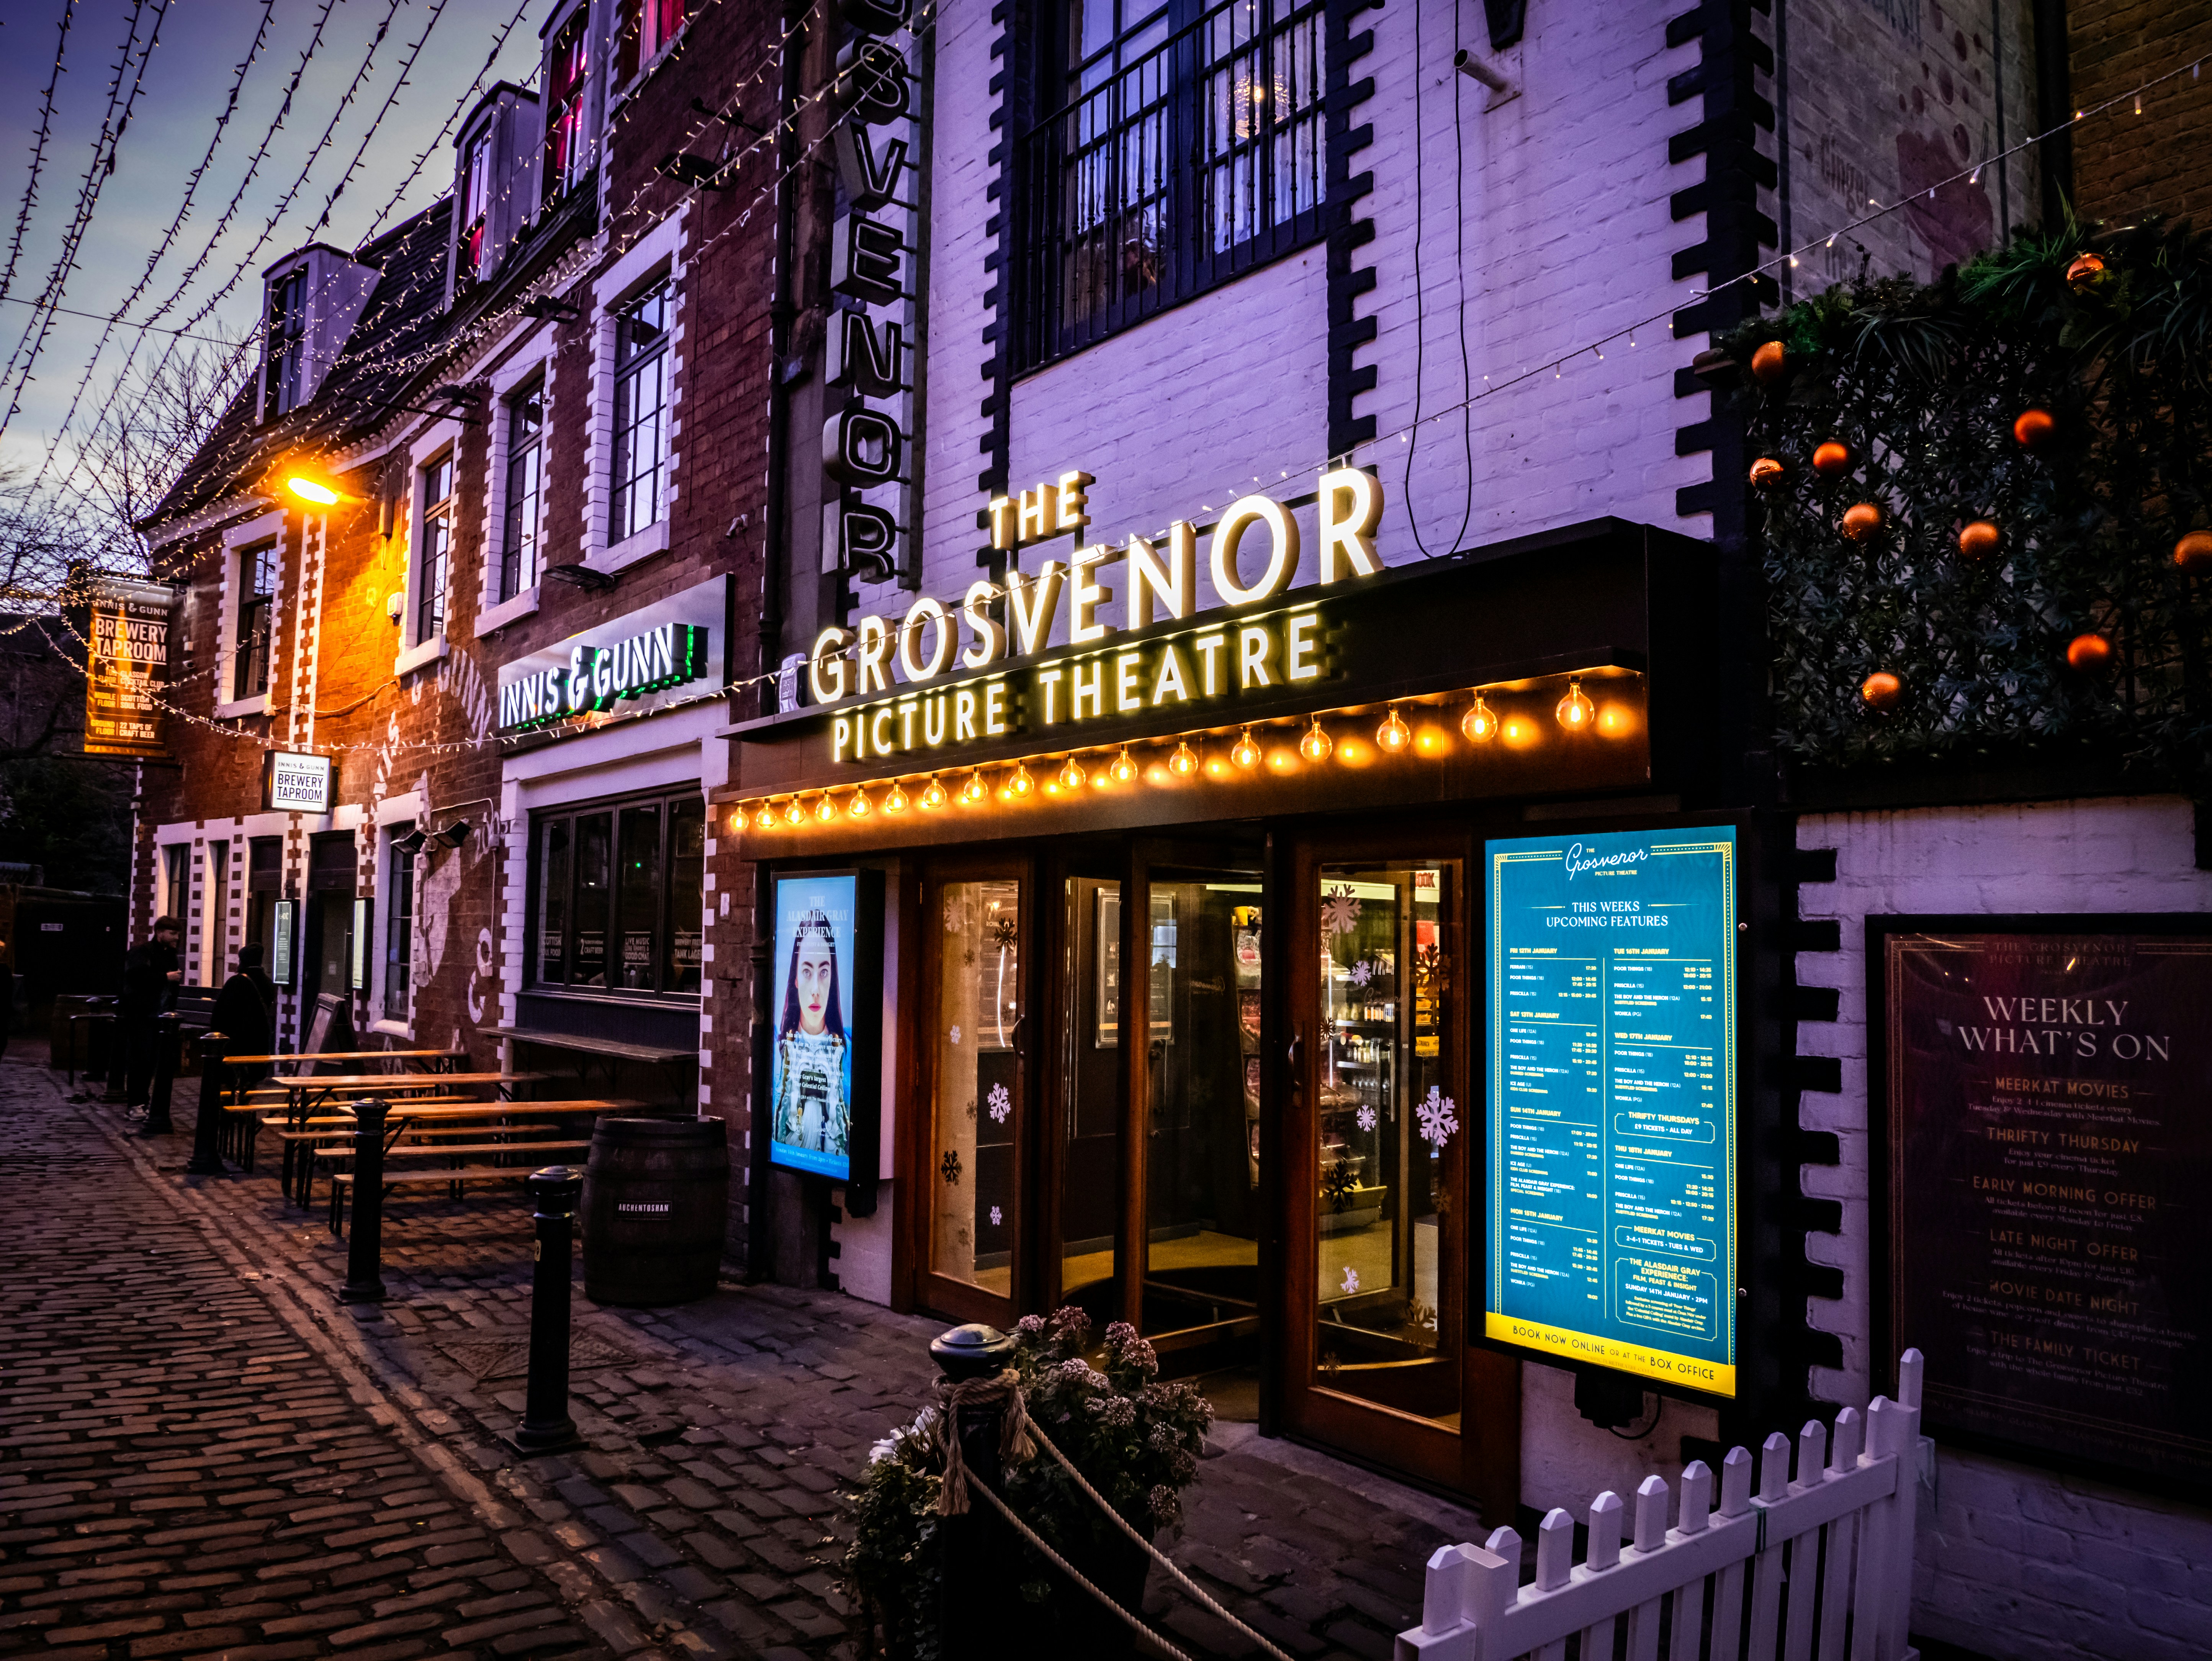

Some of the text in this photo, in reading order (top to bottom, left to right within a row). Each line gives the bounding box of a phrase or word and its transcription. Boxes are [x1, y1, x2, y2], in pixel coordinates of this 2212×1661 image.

[989, 470, 1091, 550] THE
[811, 468, 1382, 704] GROSVENOR
[128, 603, 137, 612] &
[139, 606, 167, 616] GUNN
[95, 618, 167, 643] BREWERY
[94, 637, 167, 662] TAPROOM
[499, 667, 560, 728] INNIS
[568, 645, 589, 710] &
[594, 622, 674, 697] GUNN
[94, 691, 116, 700] MIDDLE
[833, 614, 1318, 763] PICTURE THEATRE
[97, 699, 152, 711] FLOOR SOUL FOOD
[91, 719, 115, 729] GROUND
[129, 722, 144, 731] TAPS
[96, 727, 155, 739] FLOOR CRAFT BEER
[278, 773, 323, 788] BREWERY
[277, 786, 322, 801] TAPROOM
[1566, 839, 1648, 881] Grosvenor
[809, 895, 825, 907] THE
[1572, 901, 1639, 912] THIS WEEKS
[787, 909, 848, 921] ALASDAIR GRAY
[1546, 915, 1668, 927] UPCOMING FEATURES
[792, 926, 841, 938] EXPERIENCE
[1983, 996, 2128, 1027] WEEKLY
[1644, 1033, 1672, 1041] JANUARY
[1958, 1026, 2169, 1061] WHAT'S ON
[1996, 1075, 2129, 1099] MEERKAT MOVIES
[1535, 1109, 1561, 1117] JANUARY
[1628, 1111, 1700, 1125] THRIFTY THURSDAYS
[1643, 1124, 1665, 1132] TICKETS
[1986, 1126, 2139, 1153] THRIFTY THURSDAY
[2008, 1147, 2115, 1166] Enjoy your cinema ticket
[1973, 1175, 2156, 1210] EARLY MORNING OFFER
[618, 1203, 669, 1212] AUCHENTOSHAN
[1537, 1212, 1563, 1222] JANUARY
[1634, 1225, 1695, 1242] MEERKAT MOVIES
[1626, 1235, 1640, 1243] 2-4-1
[1642, 1237, 1664, 1247] TICKETS
[1669, 1242, 1683, 1250] TUES
[1690, 1245, 1703, 1253] WED
[1990, 1228, 2137, 1261] LATE NIGHT OFFER
[1630, 1257, 1700, 1277] THE ALASDAIR GRAY
[1641, 1266, 1688, 1283] EXPERIENECE:
[1633, 1274, 1647, 1283] FILM,
[1649, 1277, 1666, 1286] FEAST
[1673, 1281, 1697, 1292] INSIGHT
[1625, 1283, 1707, 1304] SUNDAY 14TH JANUARY 2PM
[1989, 1279, 2139, 1317] MOVIE DATE NIGHT
[1513, 1325, 1714, 1381] BOOK NOW ONLINE OR AT THE BOX OFFICE
[1991, 1330, 2141, 1371] THE FAMILY TICKET
